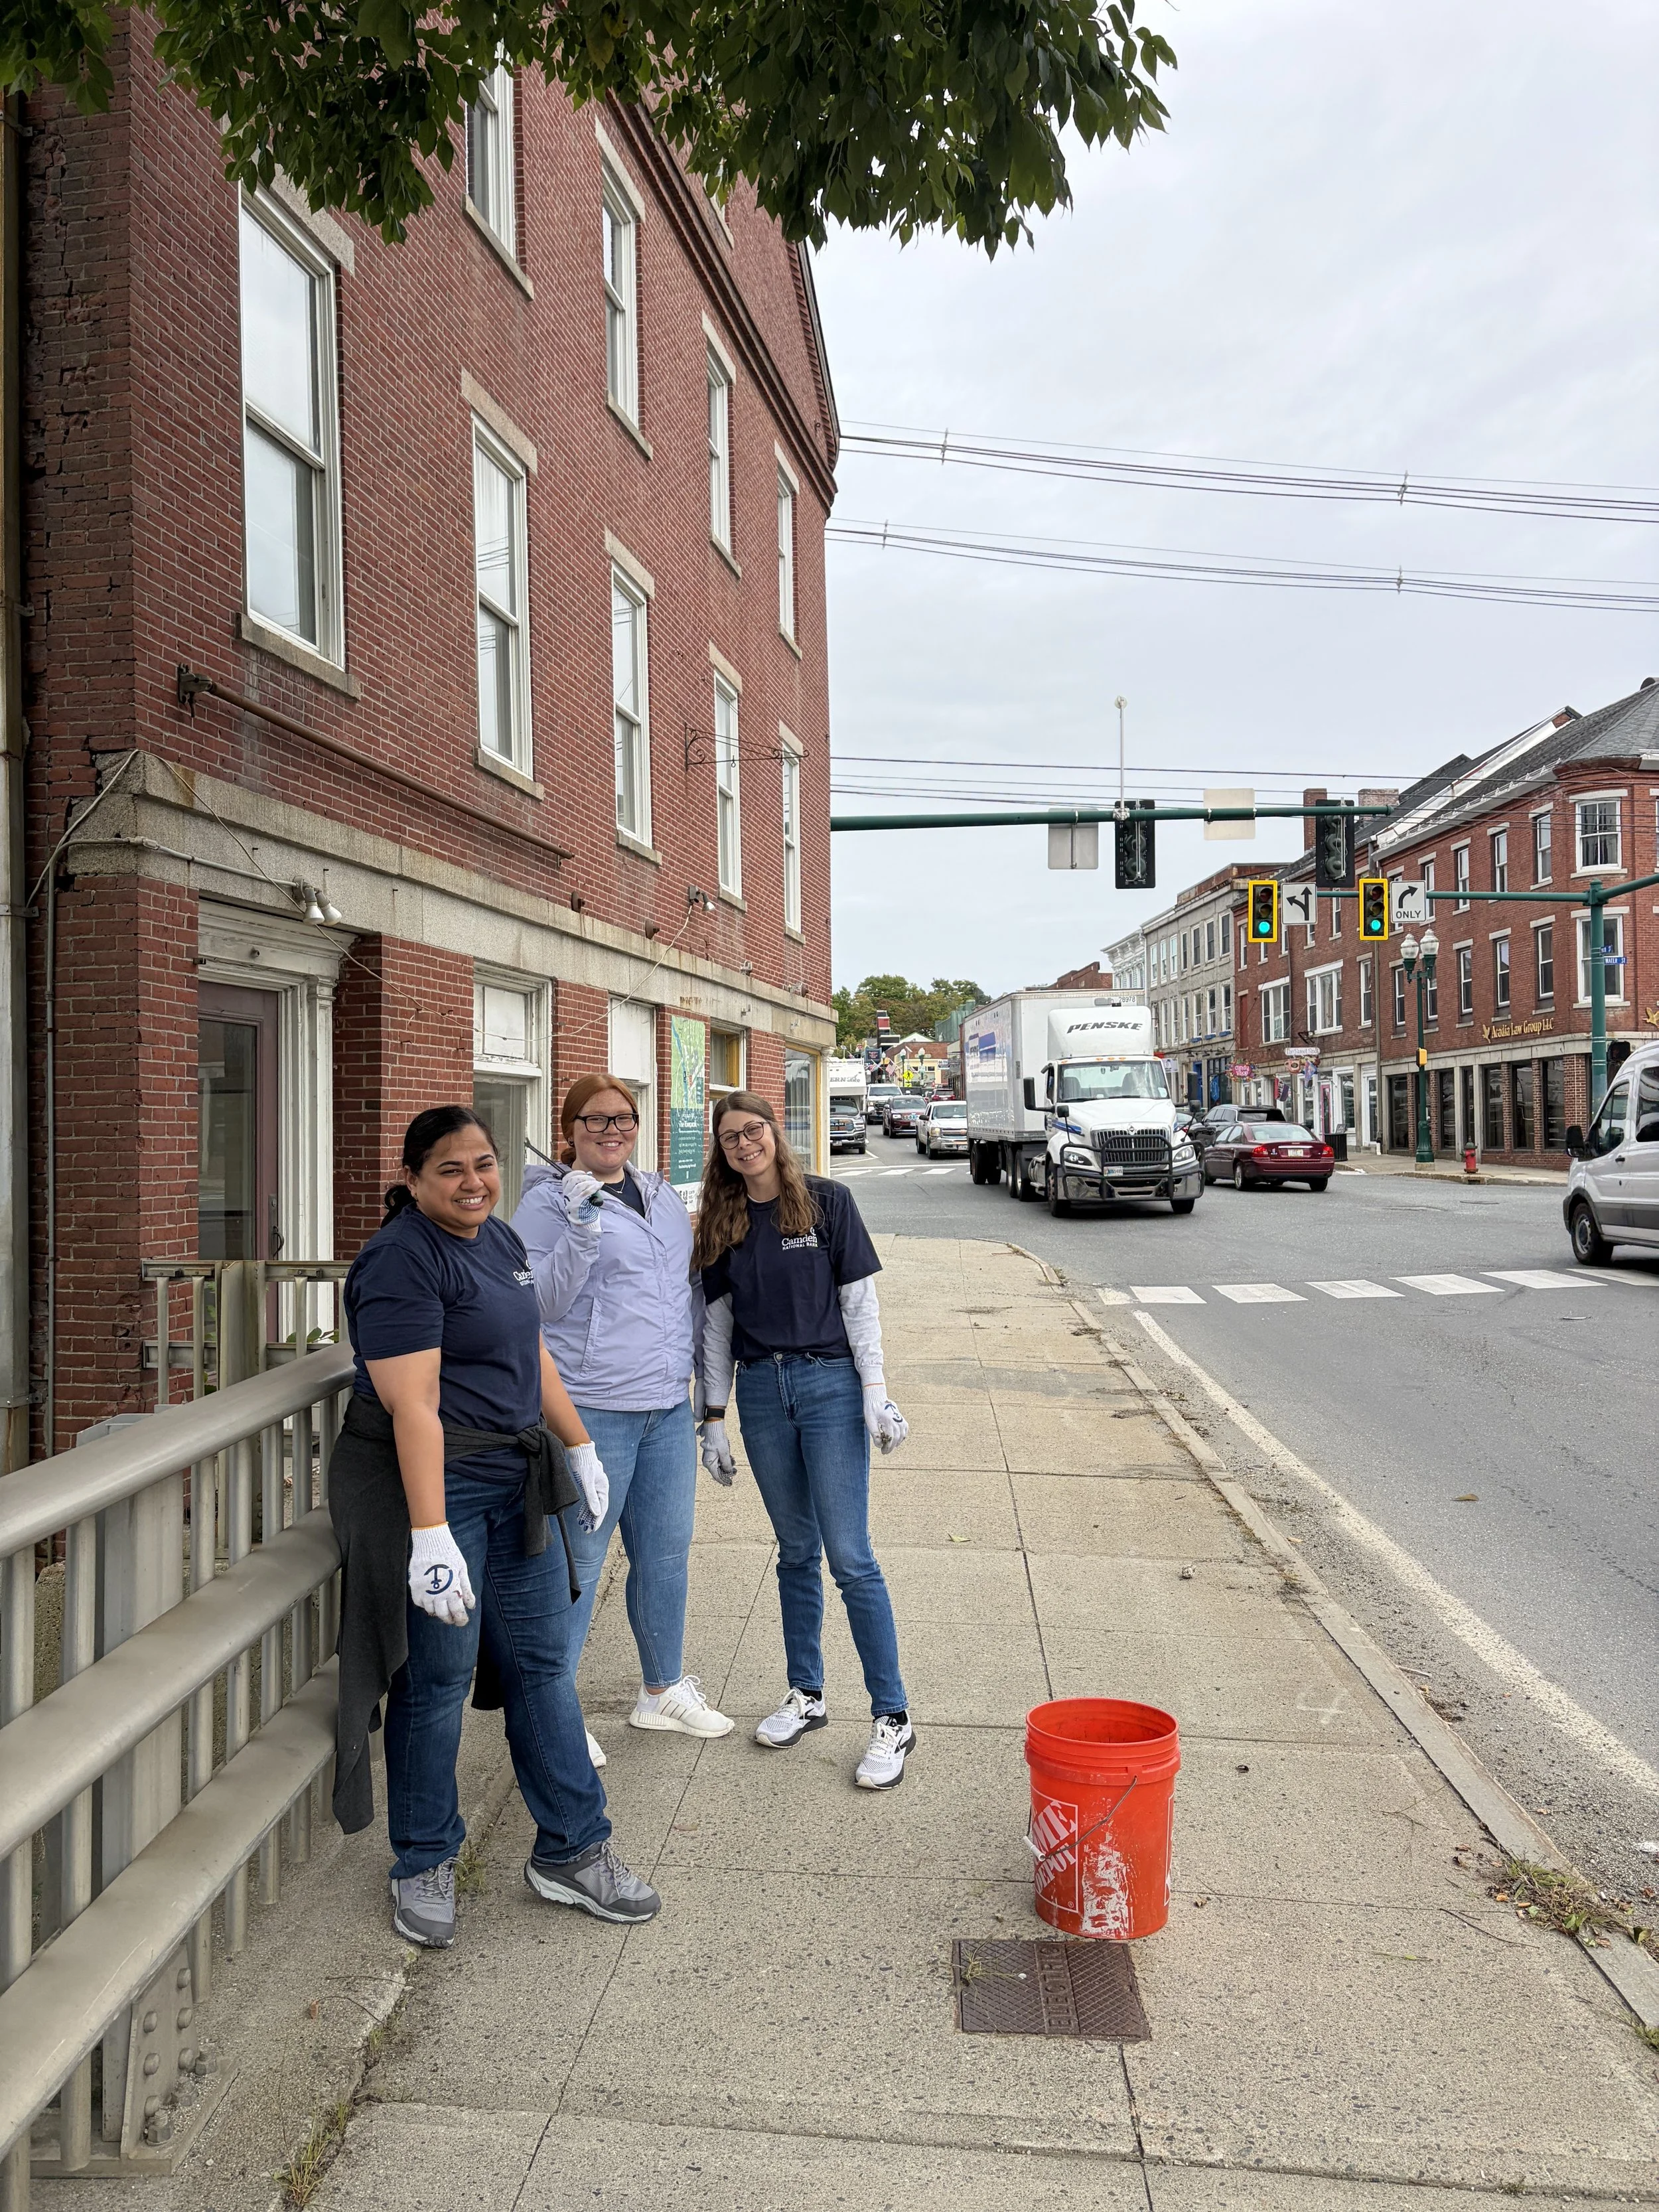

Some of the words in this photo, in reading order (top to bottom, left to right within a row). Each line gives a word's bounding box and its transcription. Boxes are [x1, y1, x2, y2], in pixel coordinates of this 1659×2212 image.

[1396, 911, 1421, 919] ONLY
[1066, 1021, 1143, 1034] PENSKE
[1491, 1024, 1510, 1039] Acadia
[1511, 1023, 1523, 1035] Law
[1524, 1020, 1542, 1035] Group
[1542, 1017, 1554, 1031] LLC
[782, 1234, 818, 1246] Camden
[1033, 1800, 1077, 1866] ME
[1035, 1842, 1077, 1894] DEPOT
[1039, 1947, 1074, 2028] ELECTRIC
